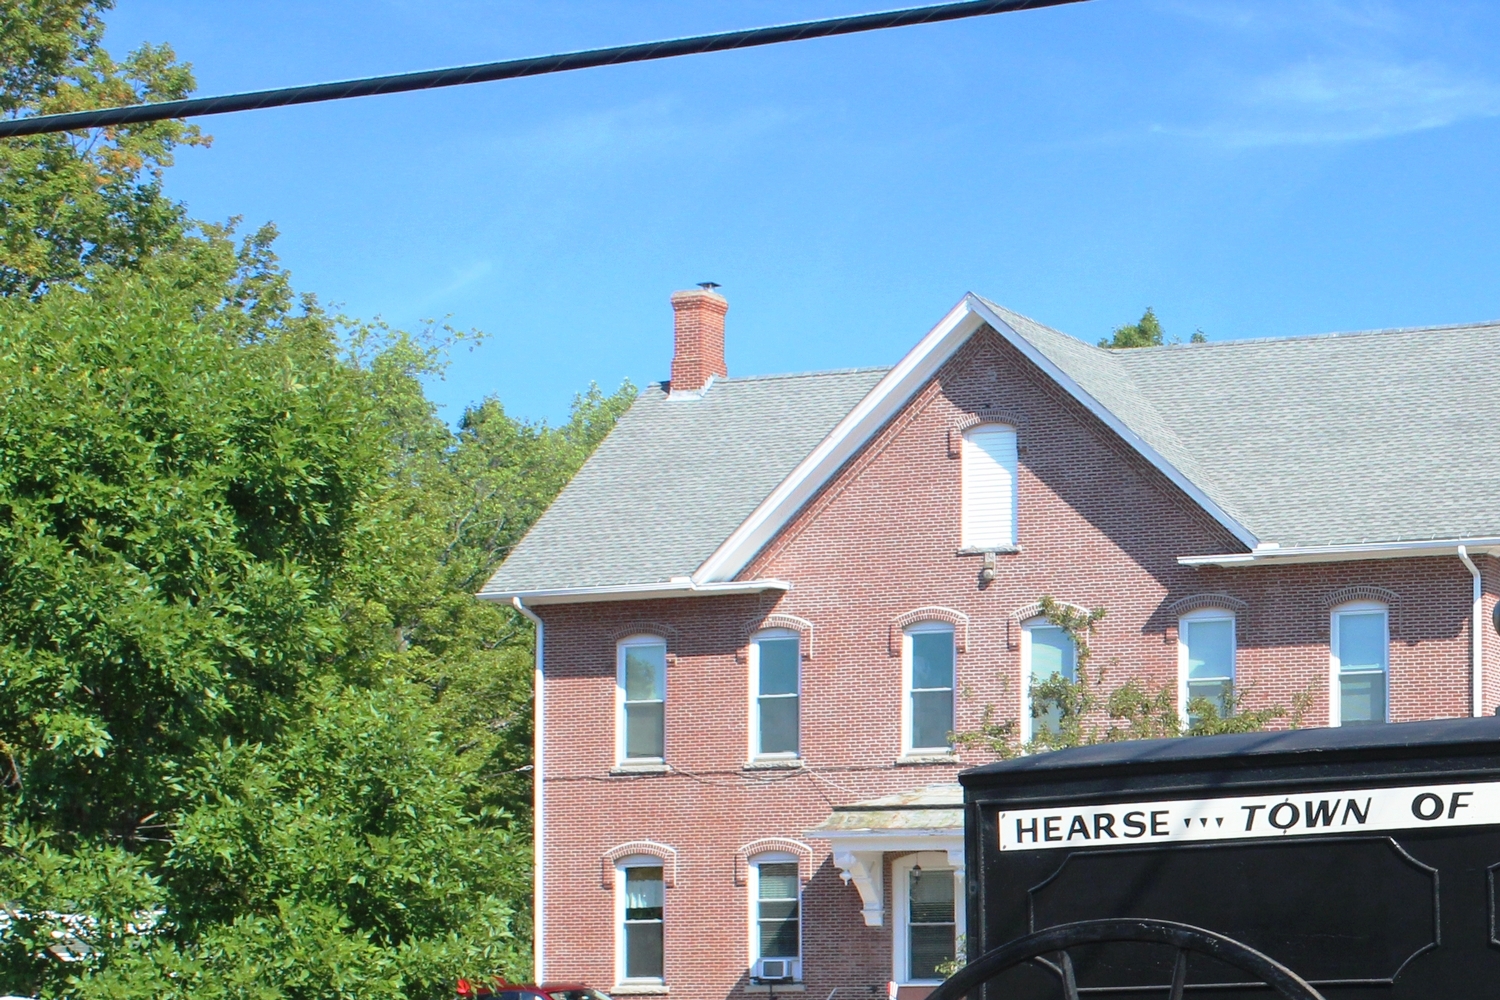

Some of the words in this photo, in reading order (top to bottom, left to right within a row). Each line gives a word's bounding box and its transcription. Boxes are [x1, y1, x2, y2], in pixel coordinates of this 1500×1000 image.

[1015, 810, 1170, 845] HEARSE
[1240, 797, 1373, 834] TOWN
[1411, 790, 1475, 821] OF
